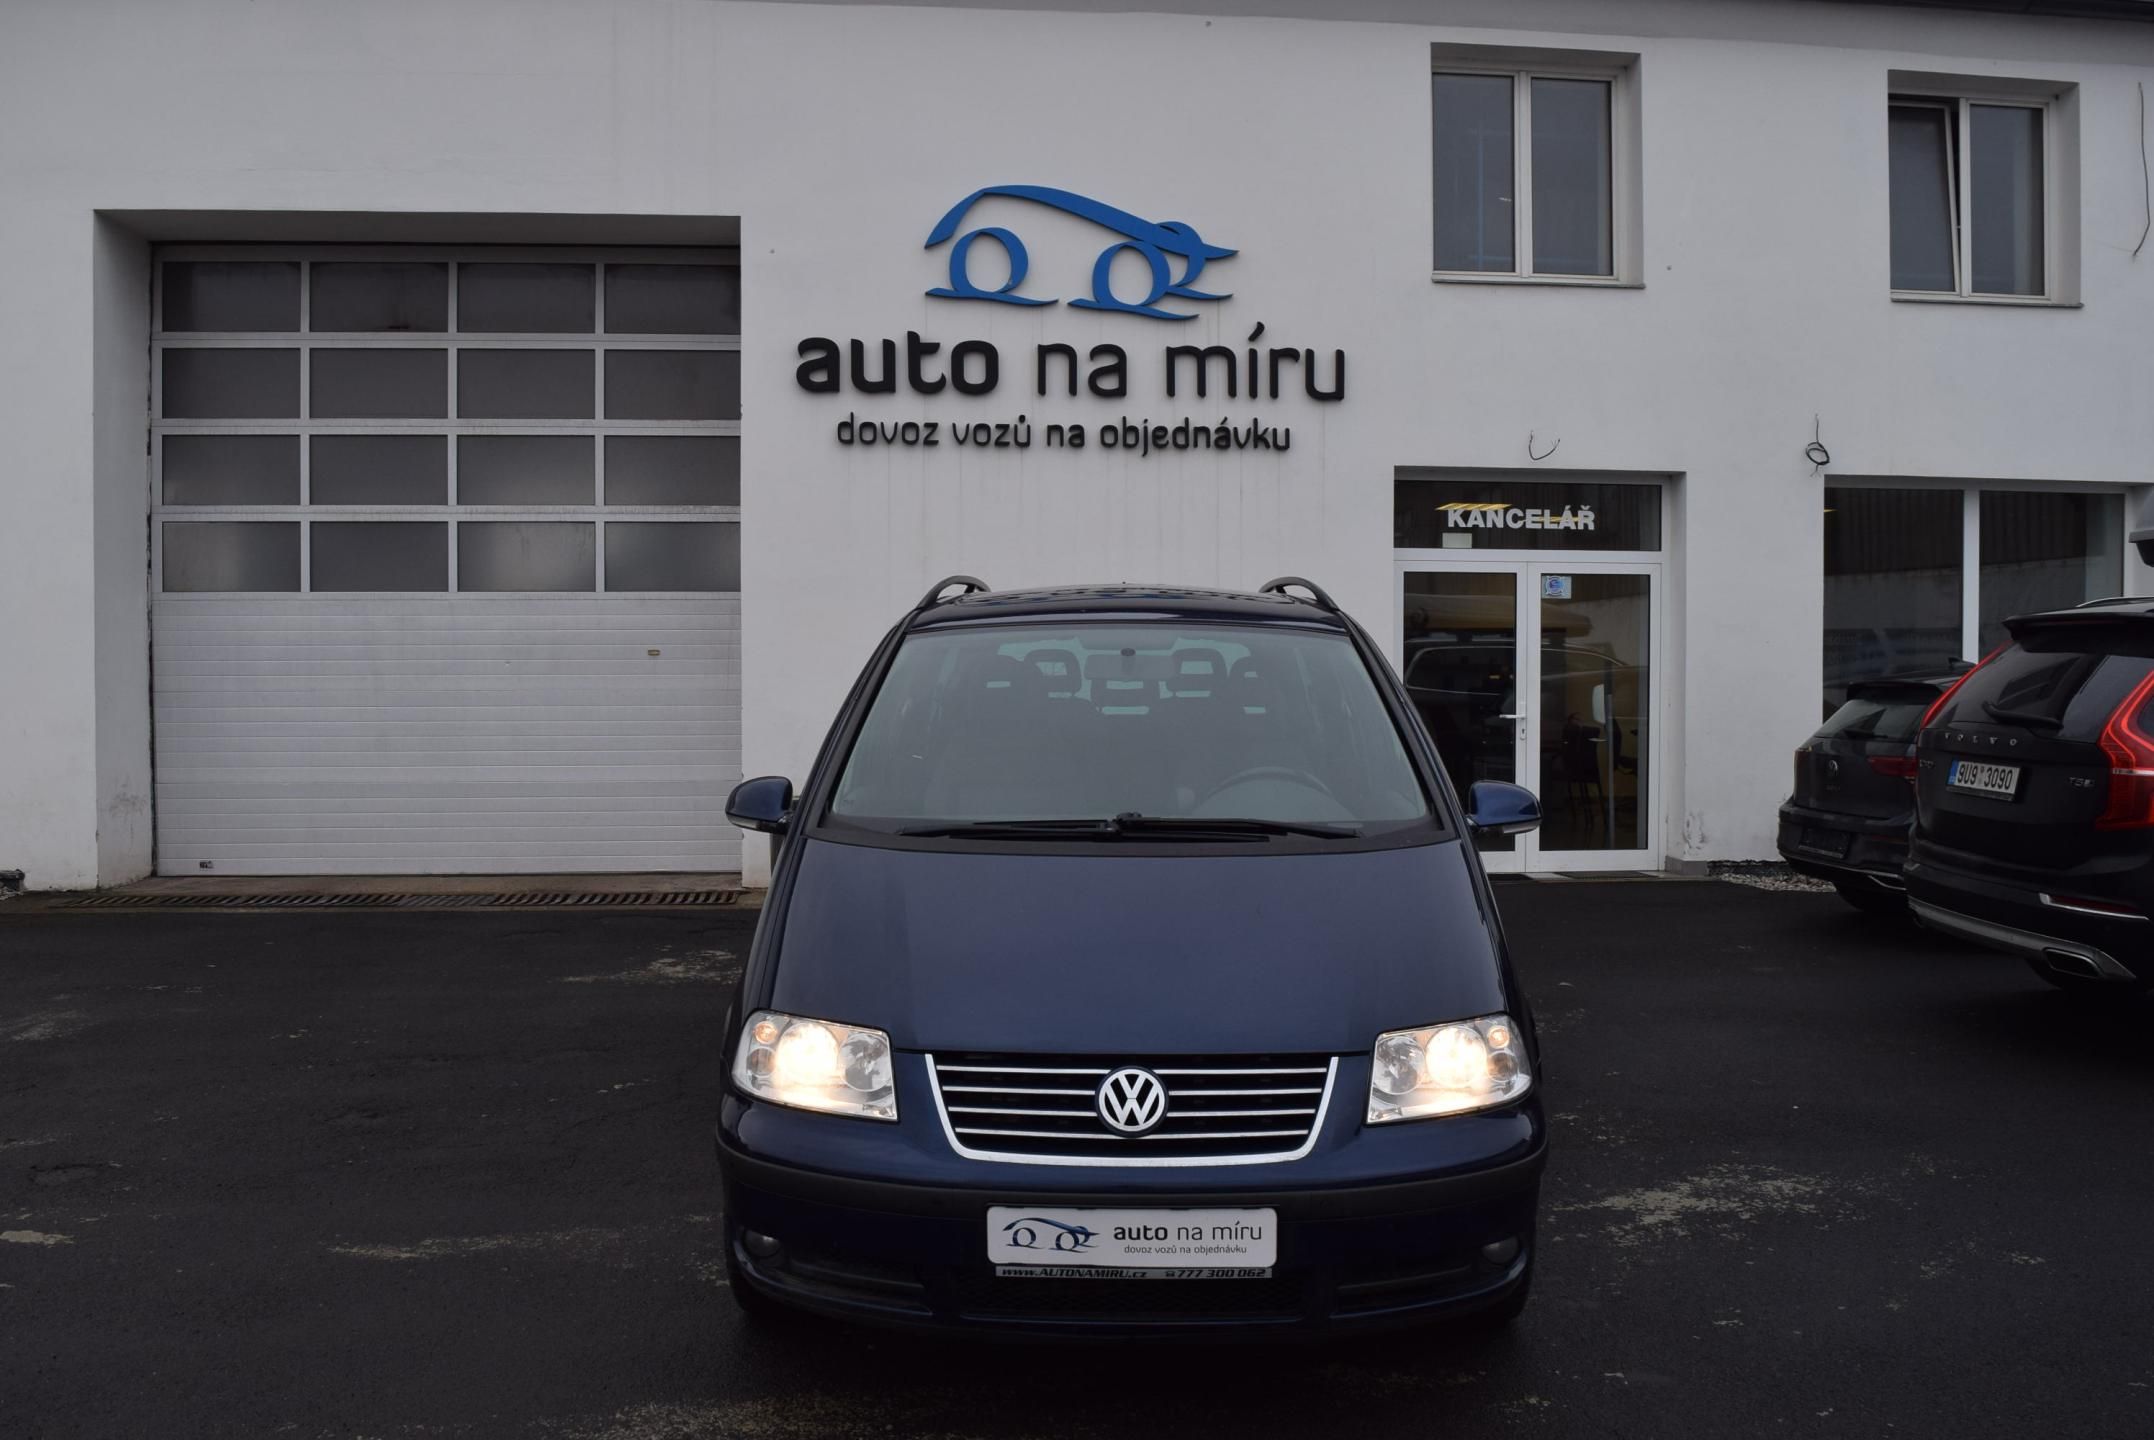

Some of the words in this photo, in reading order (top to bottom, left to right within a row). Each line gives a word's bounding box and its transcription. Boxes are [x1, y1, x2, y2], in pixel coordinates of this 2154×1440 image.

[796, 330, 999, 395] auto
[1037, 342, 1127, 397] na
[1166, 321, 1345, 401] míru
[837, 412, 939, 447] dovoz
[952, 414, 1031, 448] vozů
[1046, 422, 1085, 448] na
[1100, 416, 1290, 457] objednávku
[1447, 505, 1596, 530] KANCELÁŘ
[1944, 732, 2018, 746] VOLVO
[1957, 764, 1978, 785] 9U9
[1984, 767, 2014, 790] 3090
[1114, 1225, 1168, 1240] auto
[1178, 1227, 1203, 1240] na
[1212, 1221, 1262, 1240] míru
[1124, 1245, 1152, 1254] dovoz
[1155, 1245, 1177, 1254] vozů
[1194, 1245, 1247, 1255] objednávku
[1177, 1269, 1203, 1278] 777
[1207, 1269, 1233, 1278] 300
